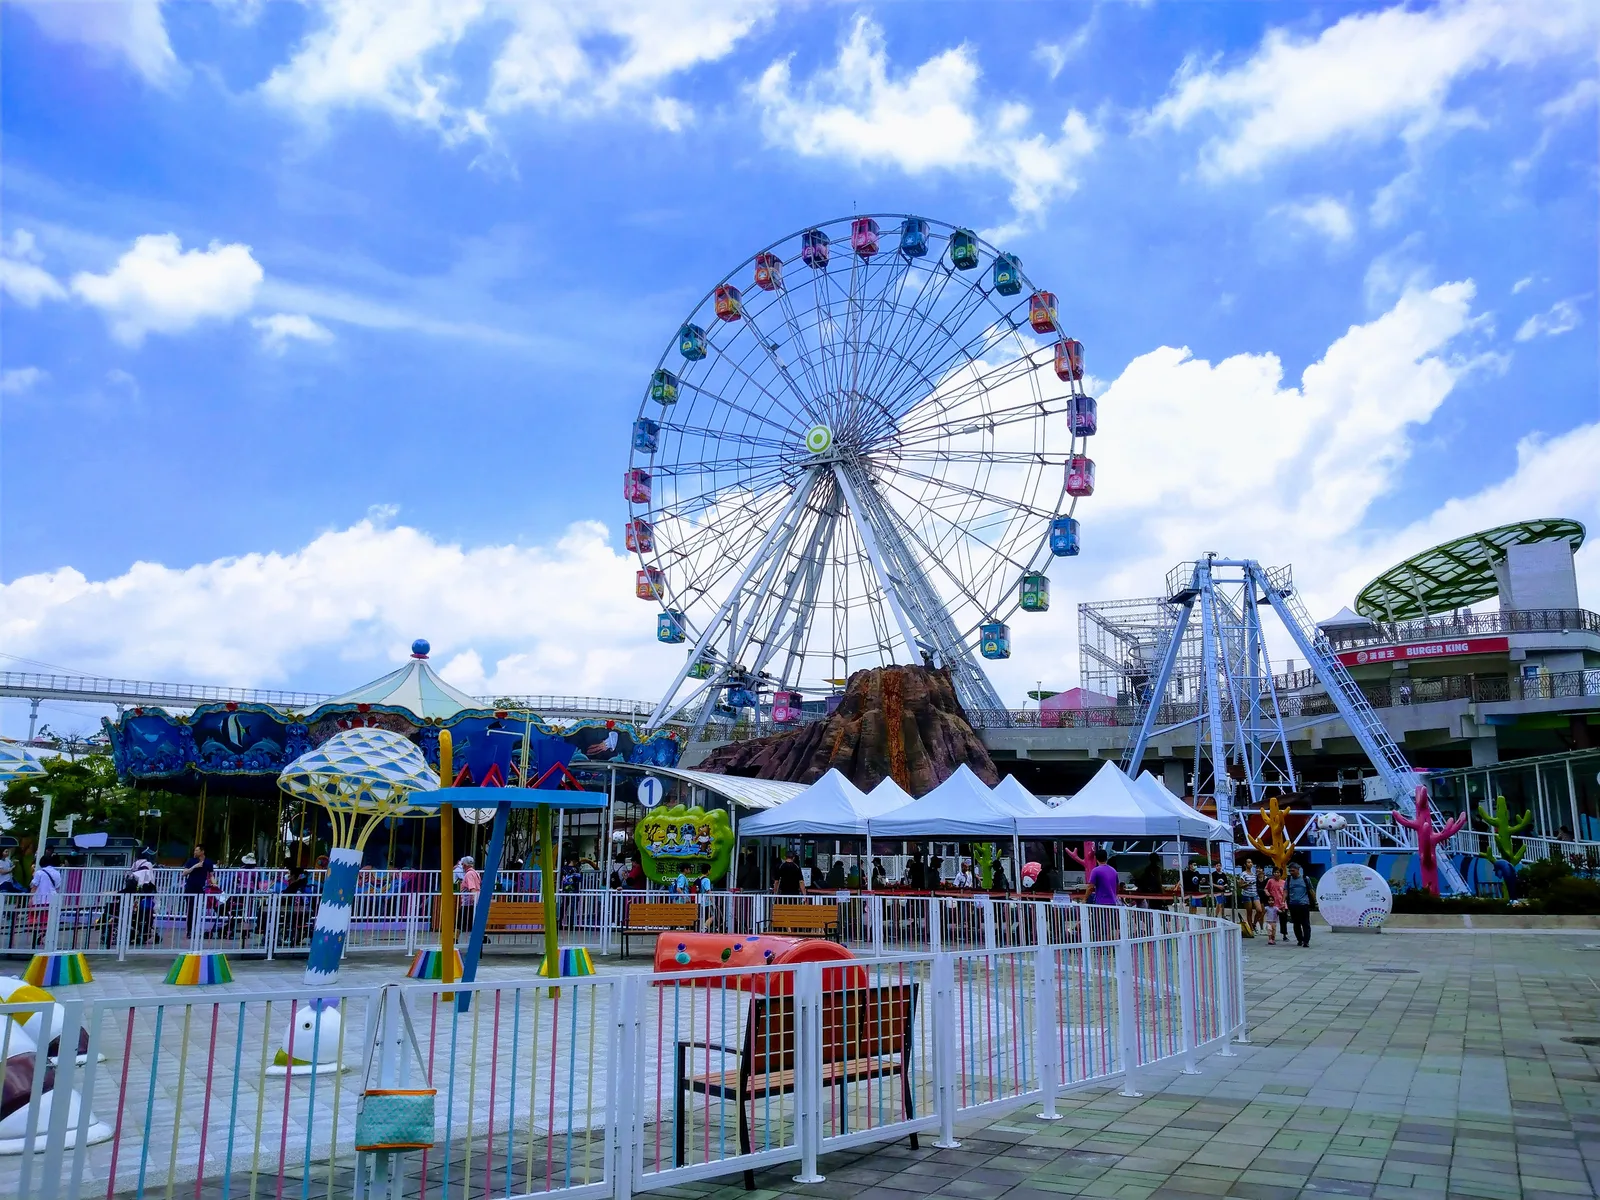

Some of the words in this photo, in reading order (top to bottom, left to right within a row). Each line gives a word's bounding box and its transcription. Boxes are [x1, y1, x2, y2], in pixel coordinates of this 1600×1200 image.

[1406, 645, 1444, 656] BURGER
[1445, 643, 1469, 653] KING
[643, 779, 654, 805] 1
